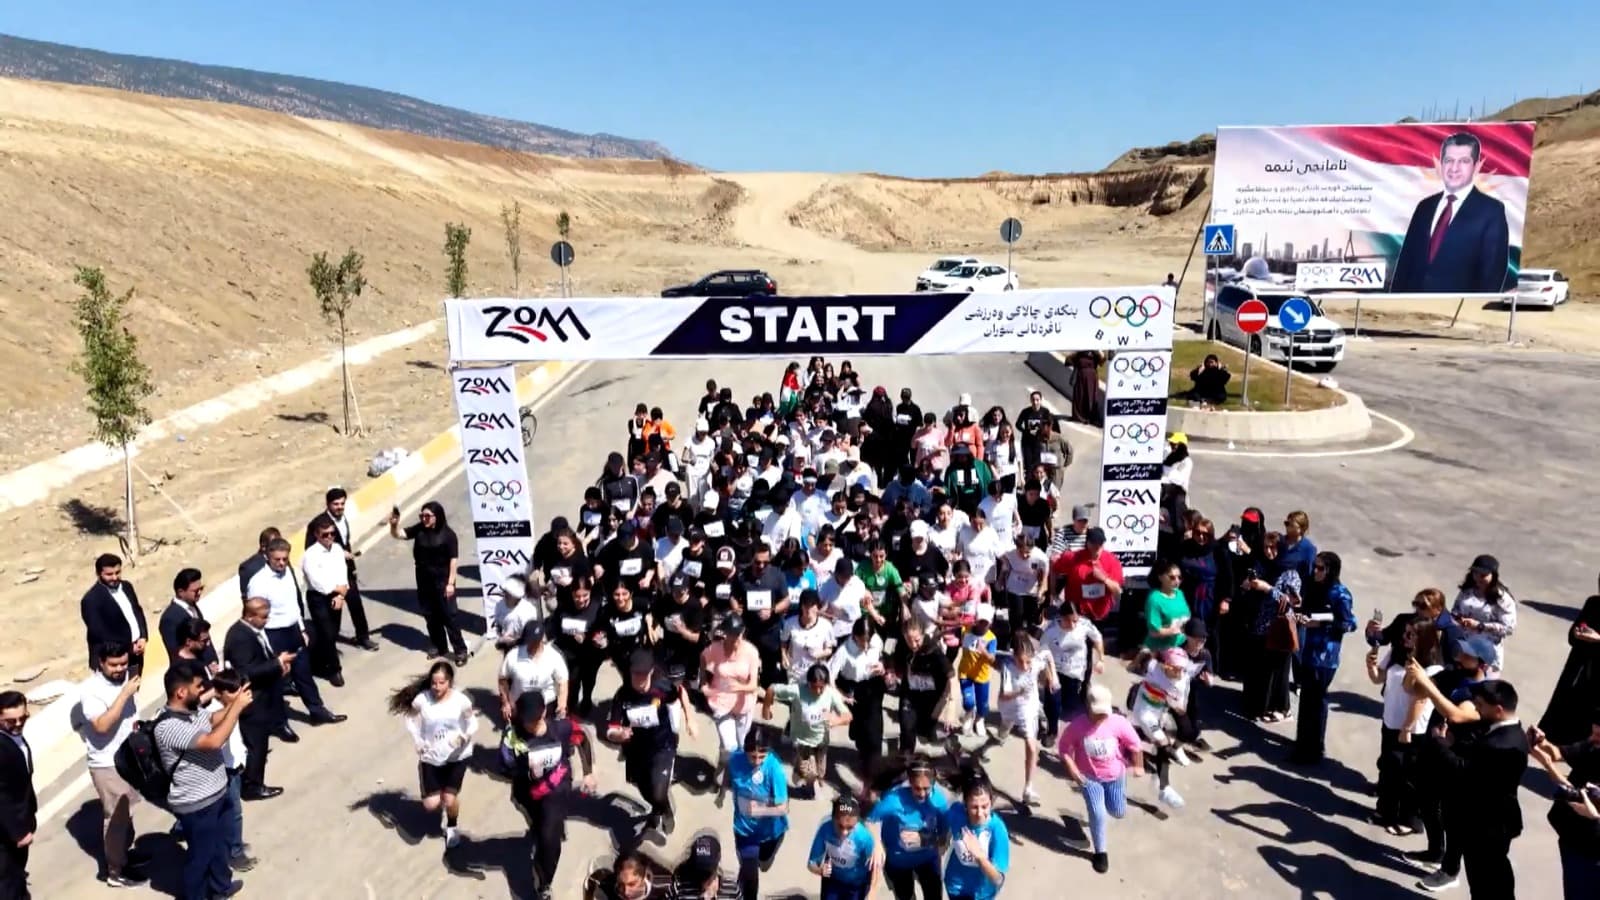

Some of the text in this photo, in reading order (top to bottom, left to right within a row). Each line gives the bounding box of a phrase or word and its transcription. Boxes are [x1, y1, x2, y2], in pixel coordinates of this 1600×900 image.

[1339, 267, 1383, 285] ZOM
[482, 306, 592, 344] ZOM
[719, 305, 896, 343] START
[458, 376, 511, 396] ZOM
[463, 412, 515, 431] ZOM
[467, 448, 519, 466] ZOM
[1107, 488, 1157, 506] ZOM
